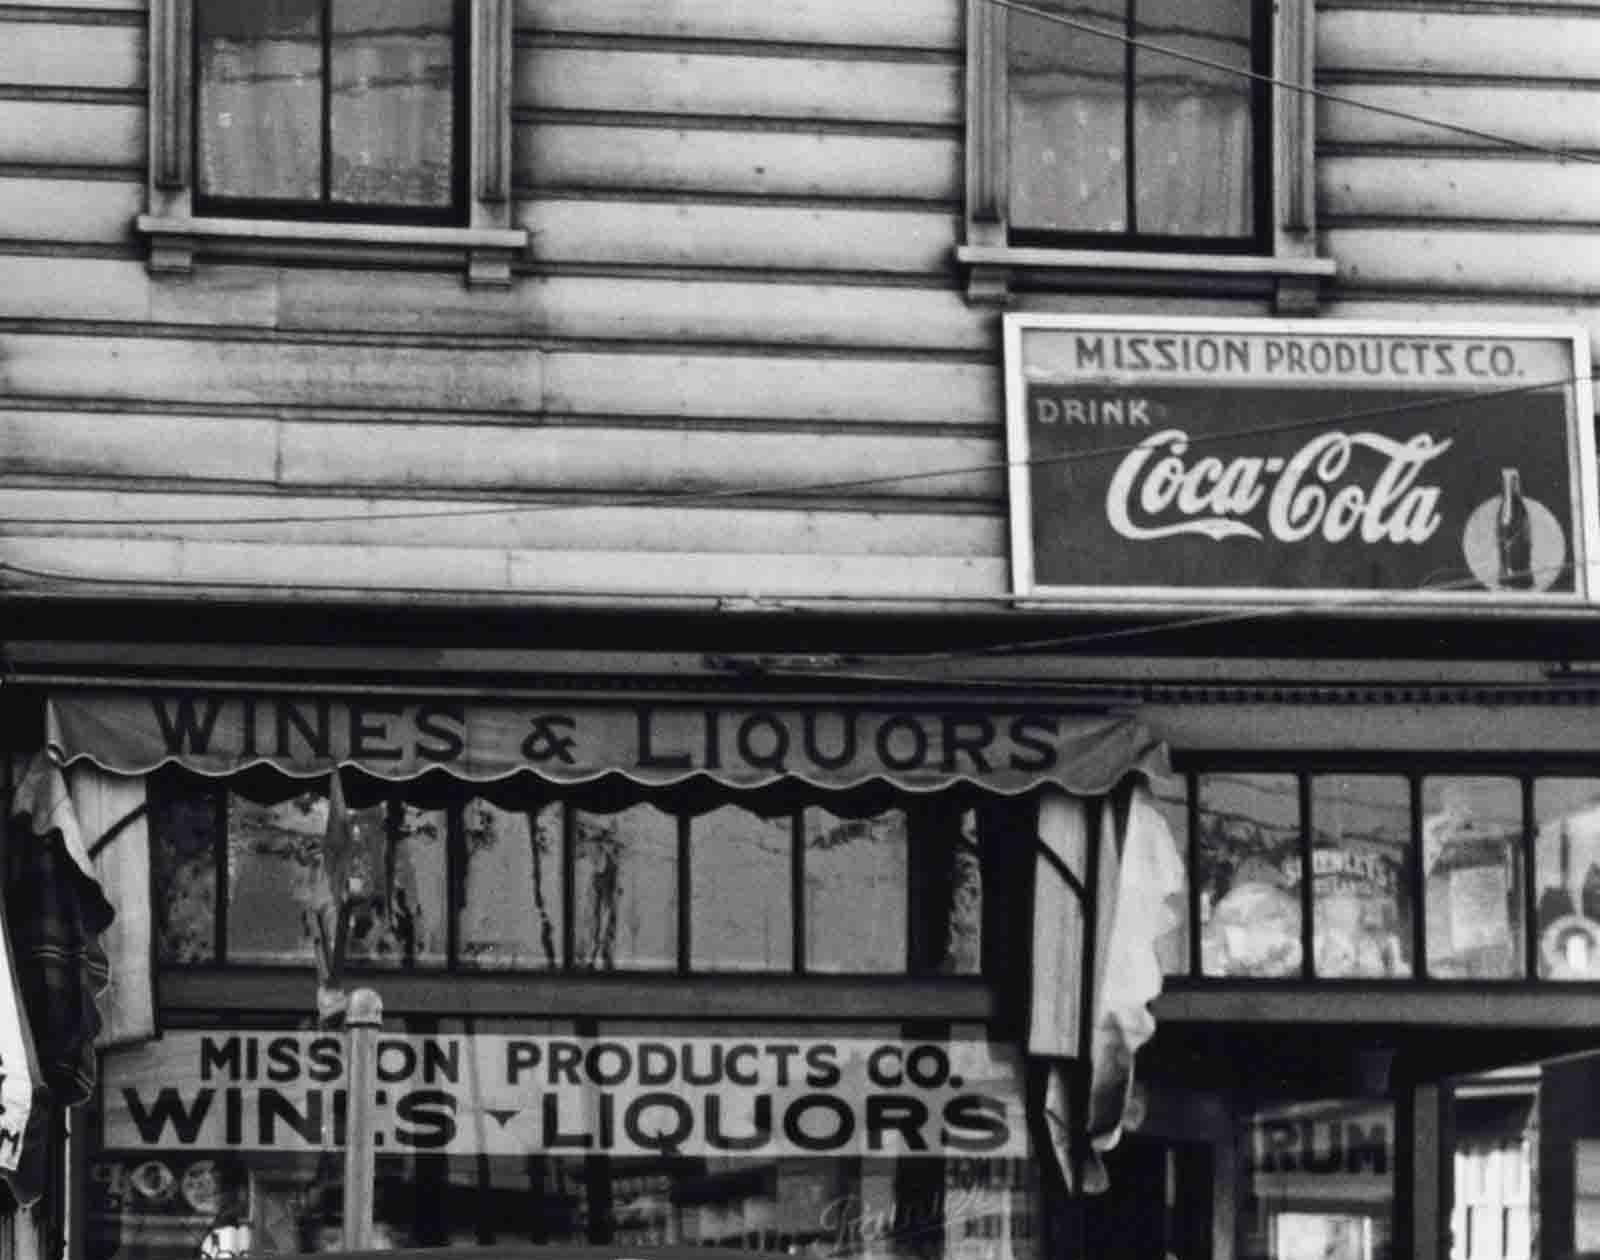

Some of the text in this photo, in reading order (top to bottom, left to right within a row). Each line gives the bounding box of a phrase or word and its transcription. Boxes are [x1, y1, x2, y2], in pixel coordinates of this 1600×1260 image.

[1076, 337, 1524, 378] MISSION PRODUCTS CO.
[1038, 398, 1152, 426] DRINK
[1106, 428, 1453, 544] Coca-Cola
[149, 697, 1061, 776] WINES & LIQUORS
[201, 1036, 965, 1089] MISSON PRODUCTS CO.
[542, 1091, 1011, 1157] LIQUORS
